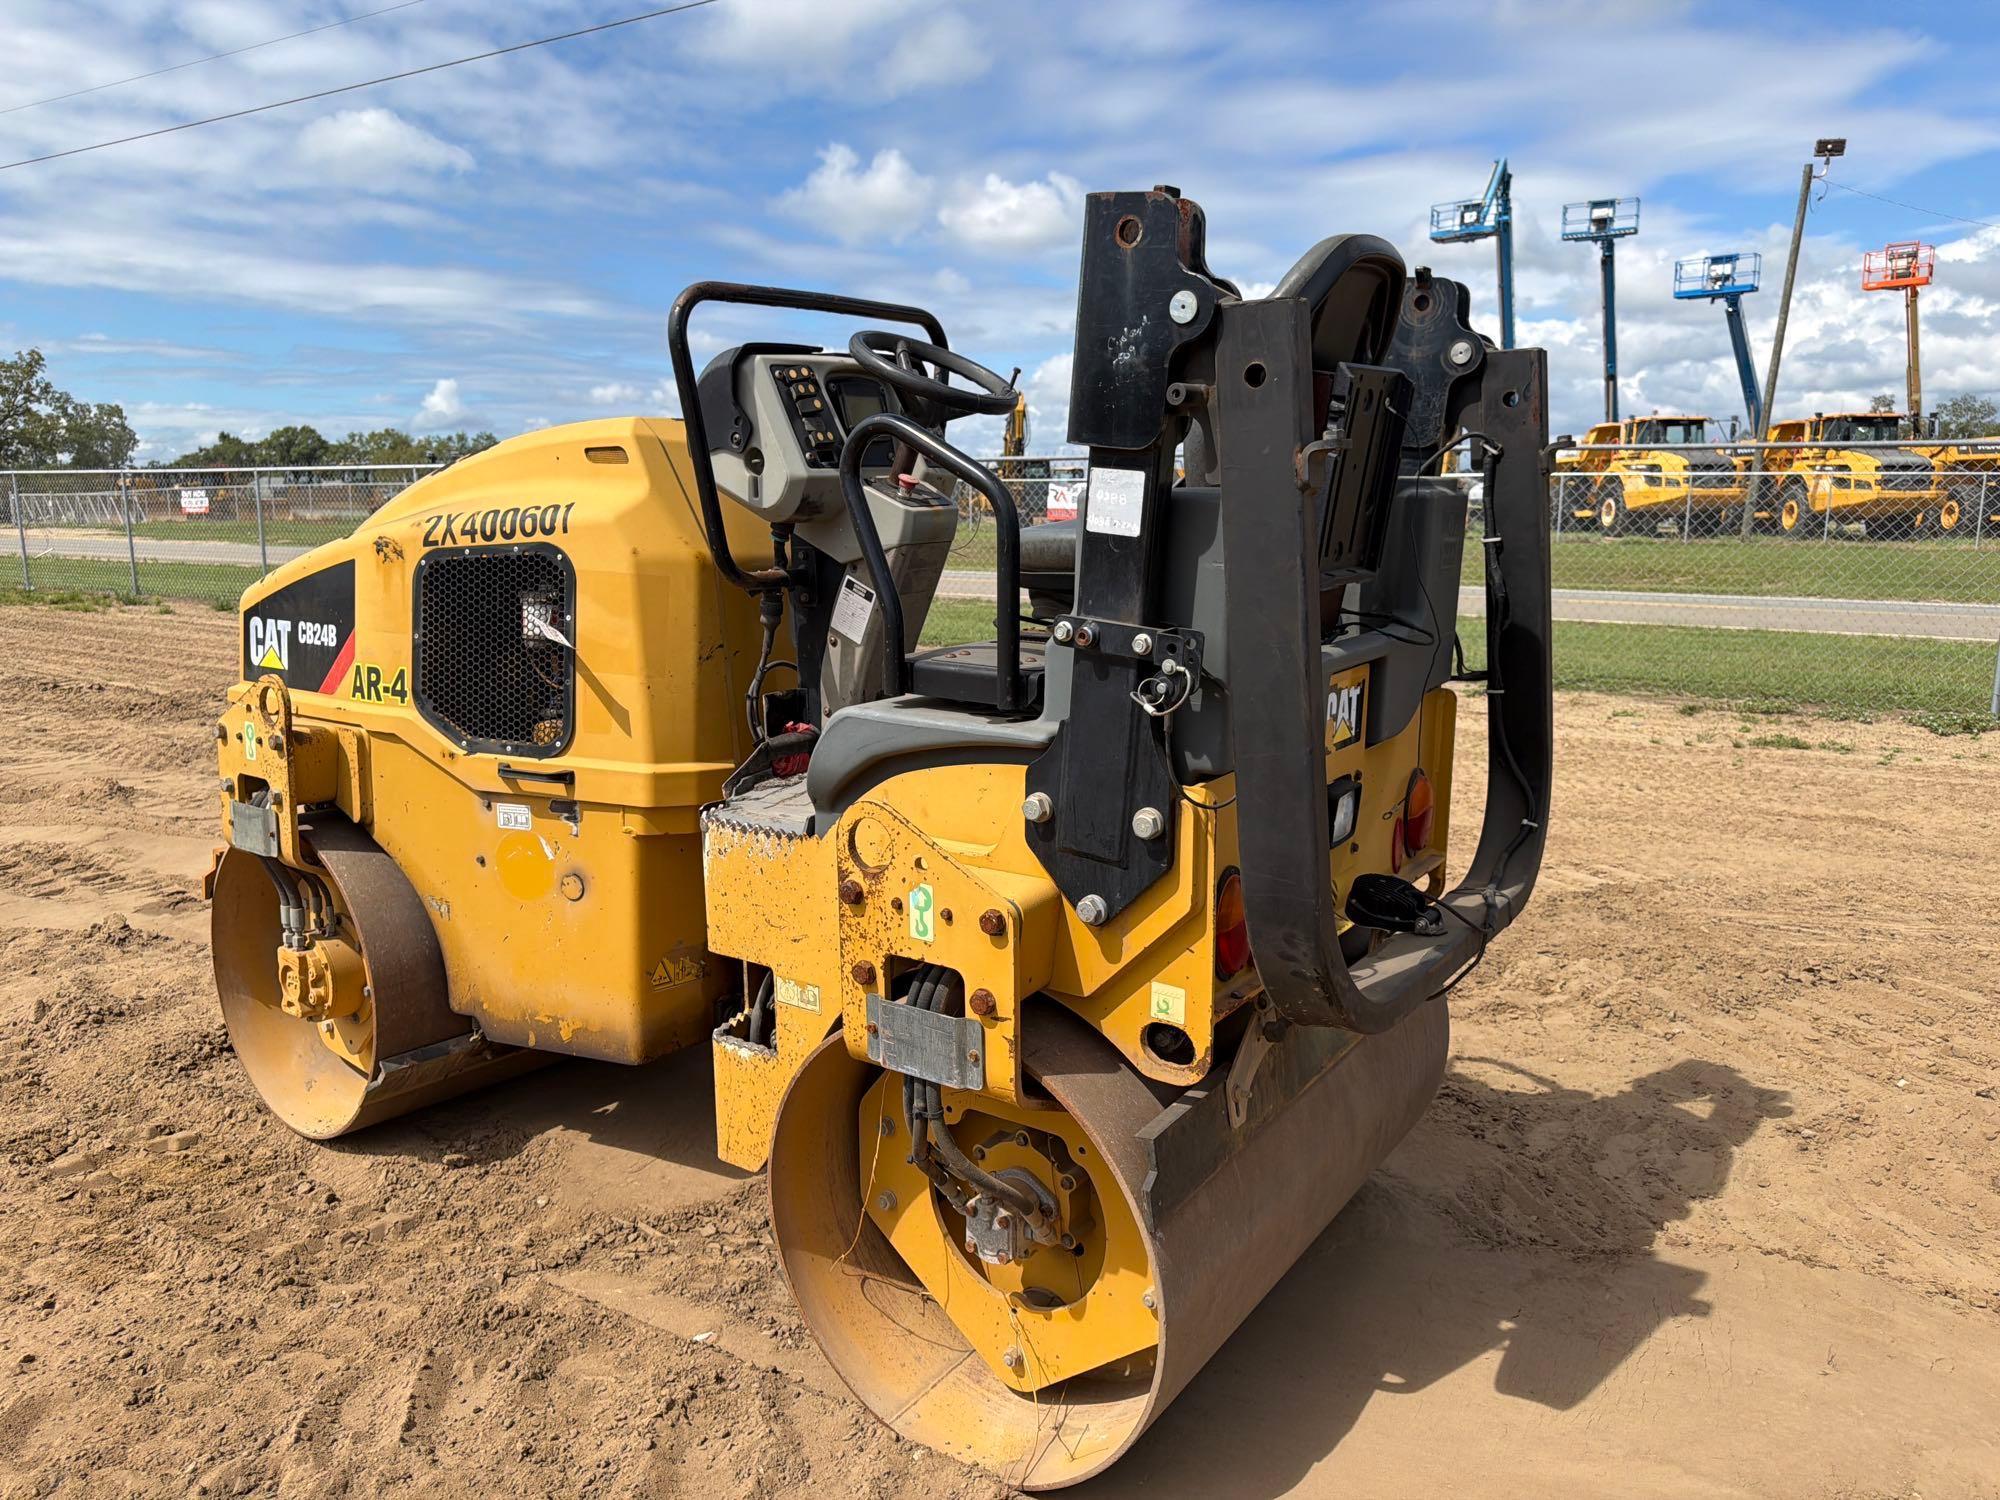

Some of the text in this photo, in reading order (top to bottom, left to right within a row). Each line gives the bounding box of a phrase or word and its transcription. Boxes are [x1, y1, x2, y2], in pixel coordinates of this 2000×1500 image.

[249, 616, 337, 671] CAT CB24B
[351, 664, 408, 705] AR-4
[1326, 685, 1361, 738] CAT
